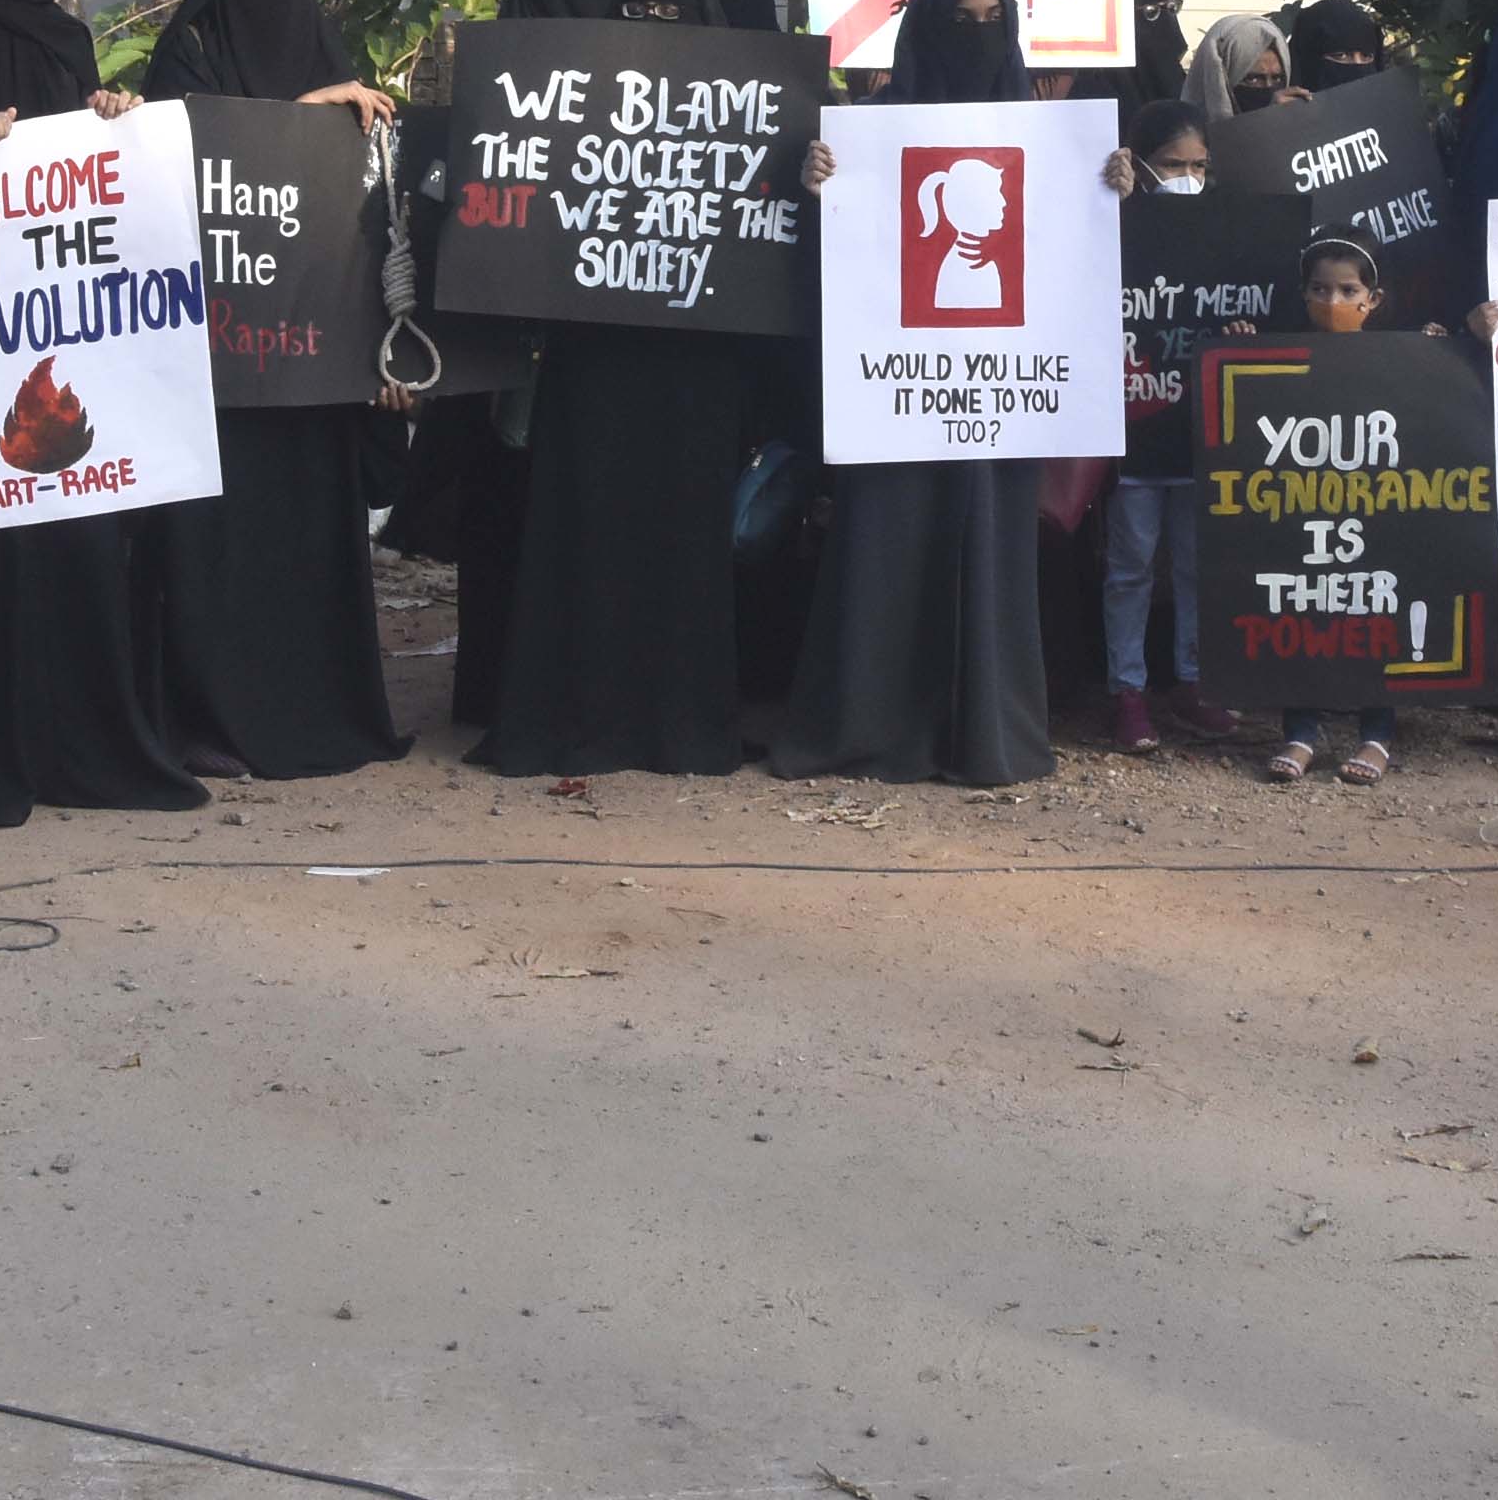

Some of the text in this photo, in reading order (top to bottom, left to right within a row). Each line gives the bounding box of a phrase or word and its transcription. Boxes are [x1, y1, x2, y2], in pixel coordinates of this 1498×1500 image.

[495, 69, 783, 136] WE BLAME
[471, 131, 551, 181] THE
[1291, 127, 1389, 193] SHATTER
[202, 158, 300, 237] Hang
[457, 181, 800, 244] BUT WE ARE THE
[22, 215, 120, 271] THE
[208, 229, 277, 286] The
[574, 236, 715, 308] SOCIETY.
[1193, 283, 1275, 318] MEAN
[209, 296, 324, 374] Rapist
[1156, 325, 1213, 362] YE
[860, 352, 1070, 383] WOULD YOU LIKE
[894, 387, 1060, 415] IT DONE TO YOU
[942, 419, 1002, 447] TOO?
[1256, 410, 1399, 472] YOUR
[1208, 466, 1491, 523] IGNORANCE
[1302, 518, 1366, 565] IS
[1256, 570, 1398, 615] THEIR
